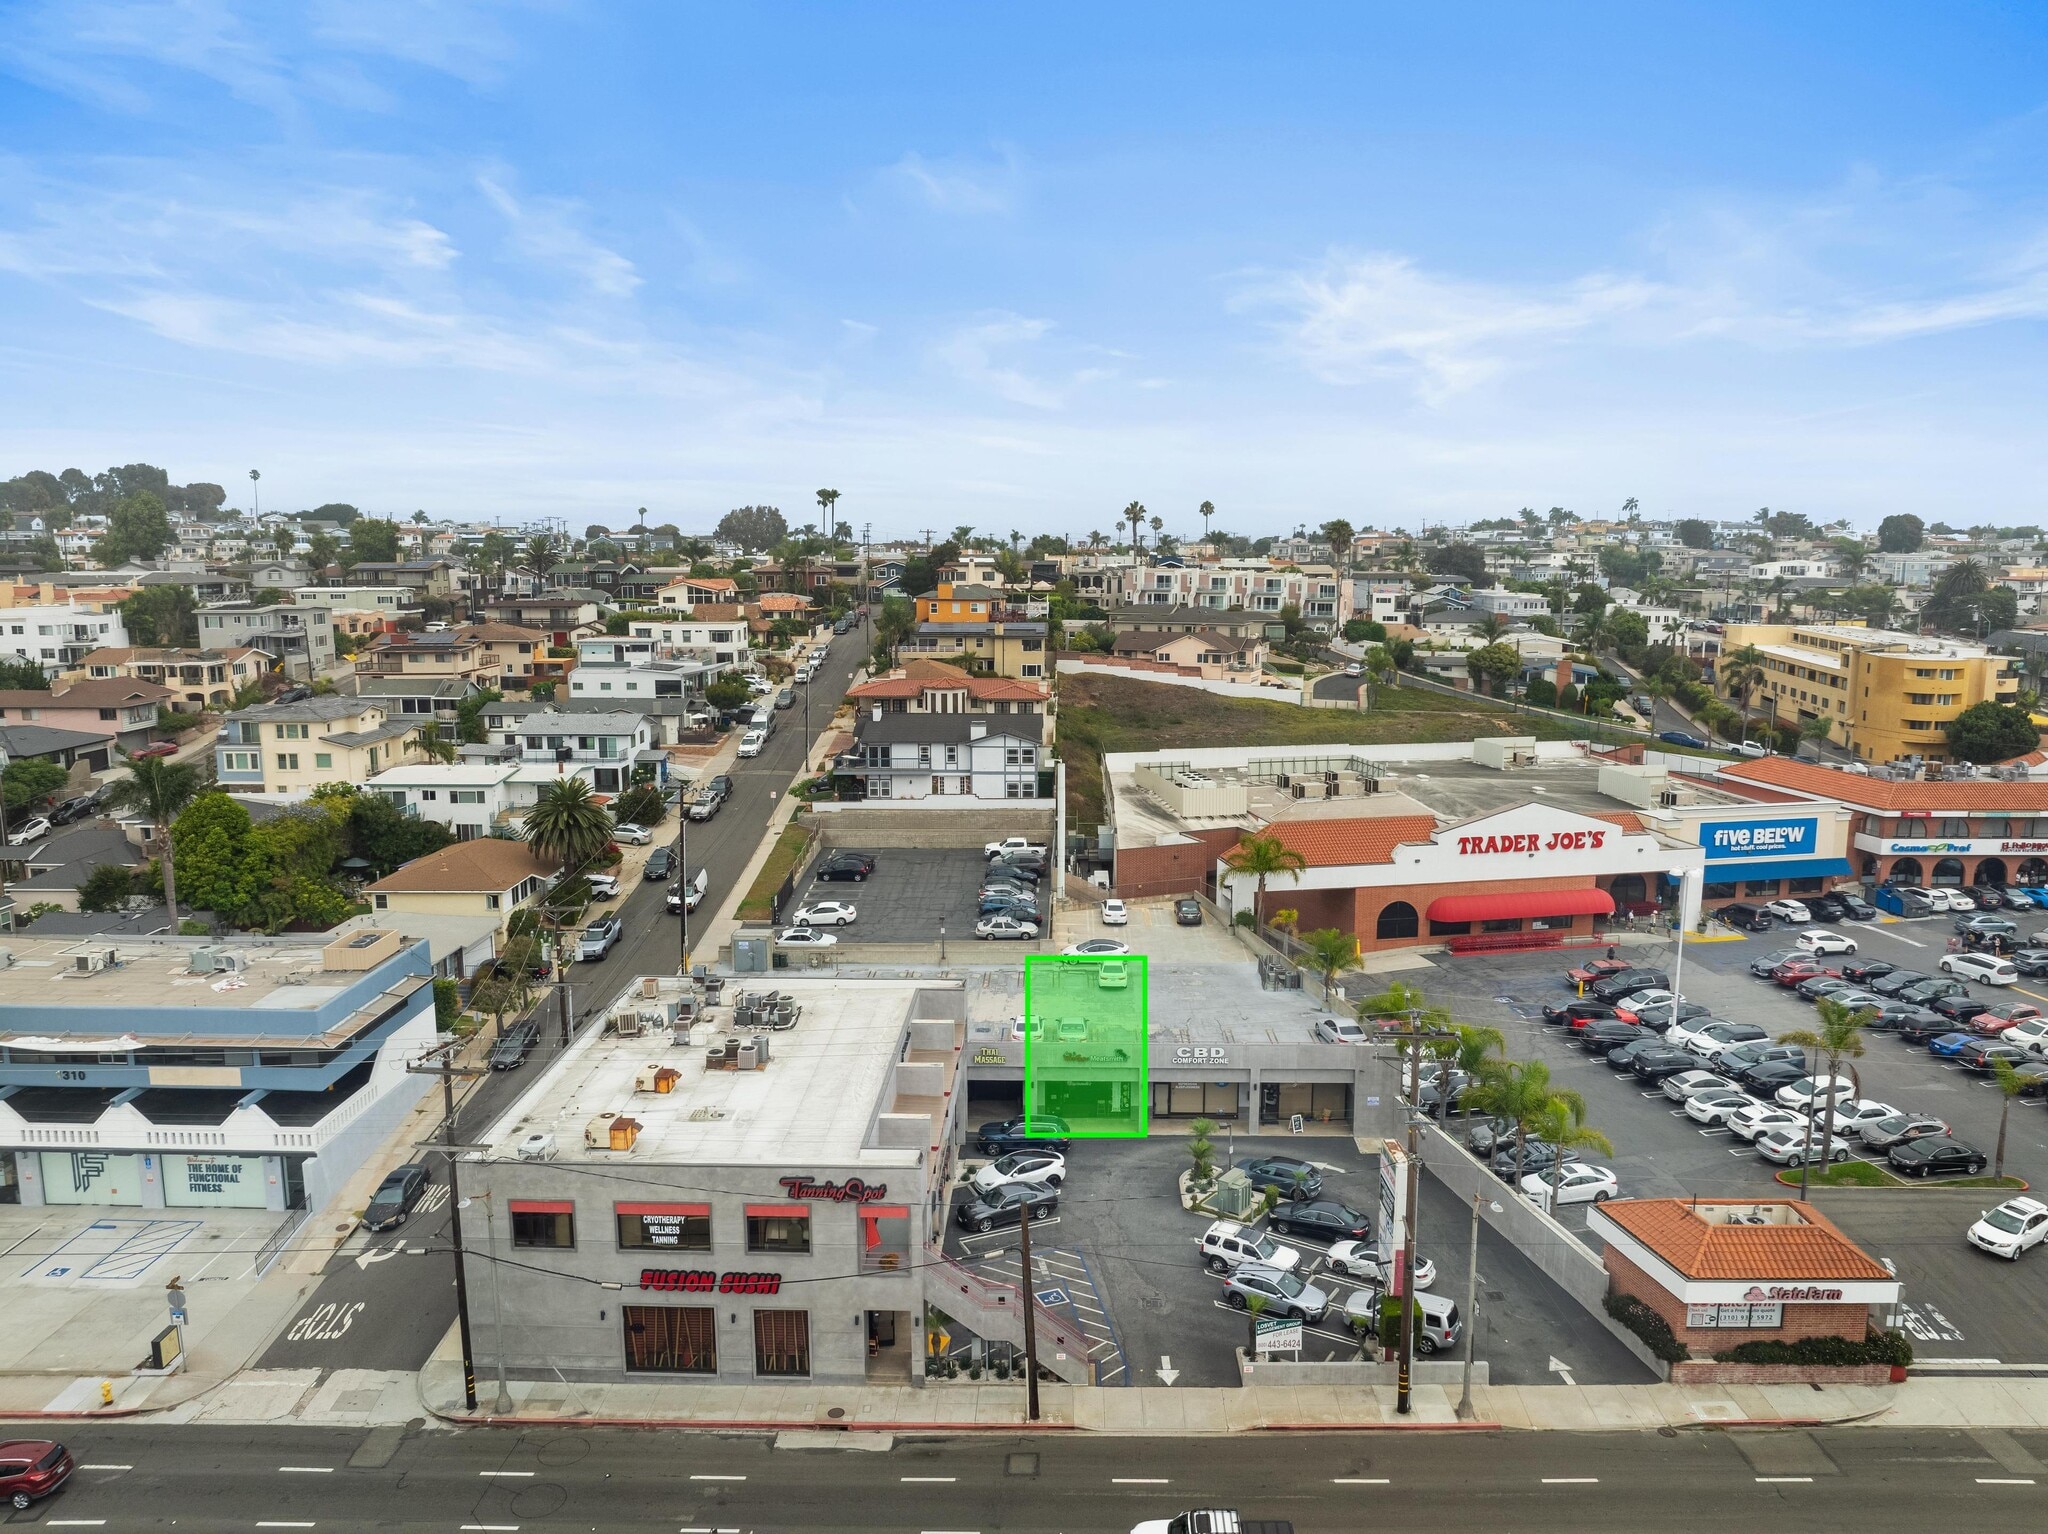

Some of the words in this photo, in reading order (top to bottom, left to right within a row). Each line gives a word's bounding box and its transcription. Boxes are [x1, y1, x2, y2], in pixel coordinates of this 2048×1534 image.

[1714, 828, 1751, 846] five
[1457, 834, 1540, 854] TRADER
[1545, 831, 1606, 850] JOE'S
[1947, 843, 1971, 853] Prof
[1176, 1047, 1225, 1058] CBD
[187, 1164, 203, 1173] THE
[205, 1164, 229, 1173] HOME
[231, 1164, 243, 1173] OF
[188, 1173, 240, 1183] FUNCTIONAL
[643, 1215, 686, 1224] CRYOTHERAPY
[649, 1225, 680, 1234] WELLNESS
[651, 1235, 678, 1245] TANNING
[640, 1269, 716, 1292] FUSION
[719, 1272, 781, 1294] SUSHI
[288, 1302, 365, 1341] STOP
[1283, 1328, 1299, 1336] LEASE
[1267, 1340, 1301, 1349] 443-6424
